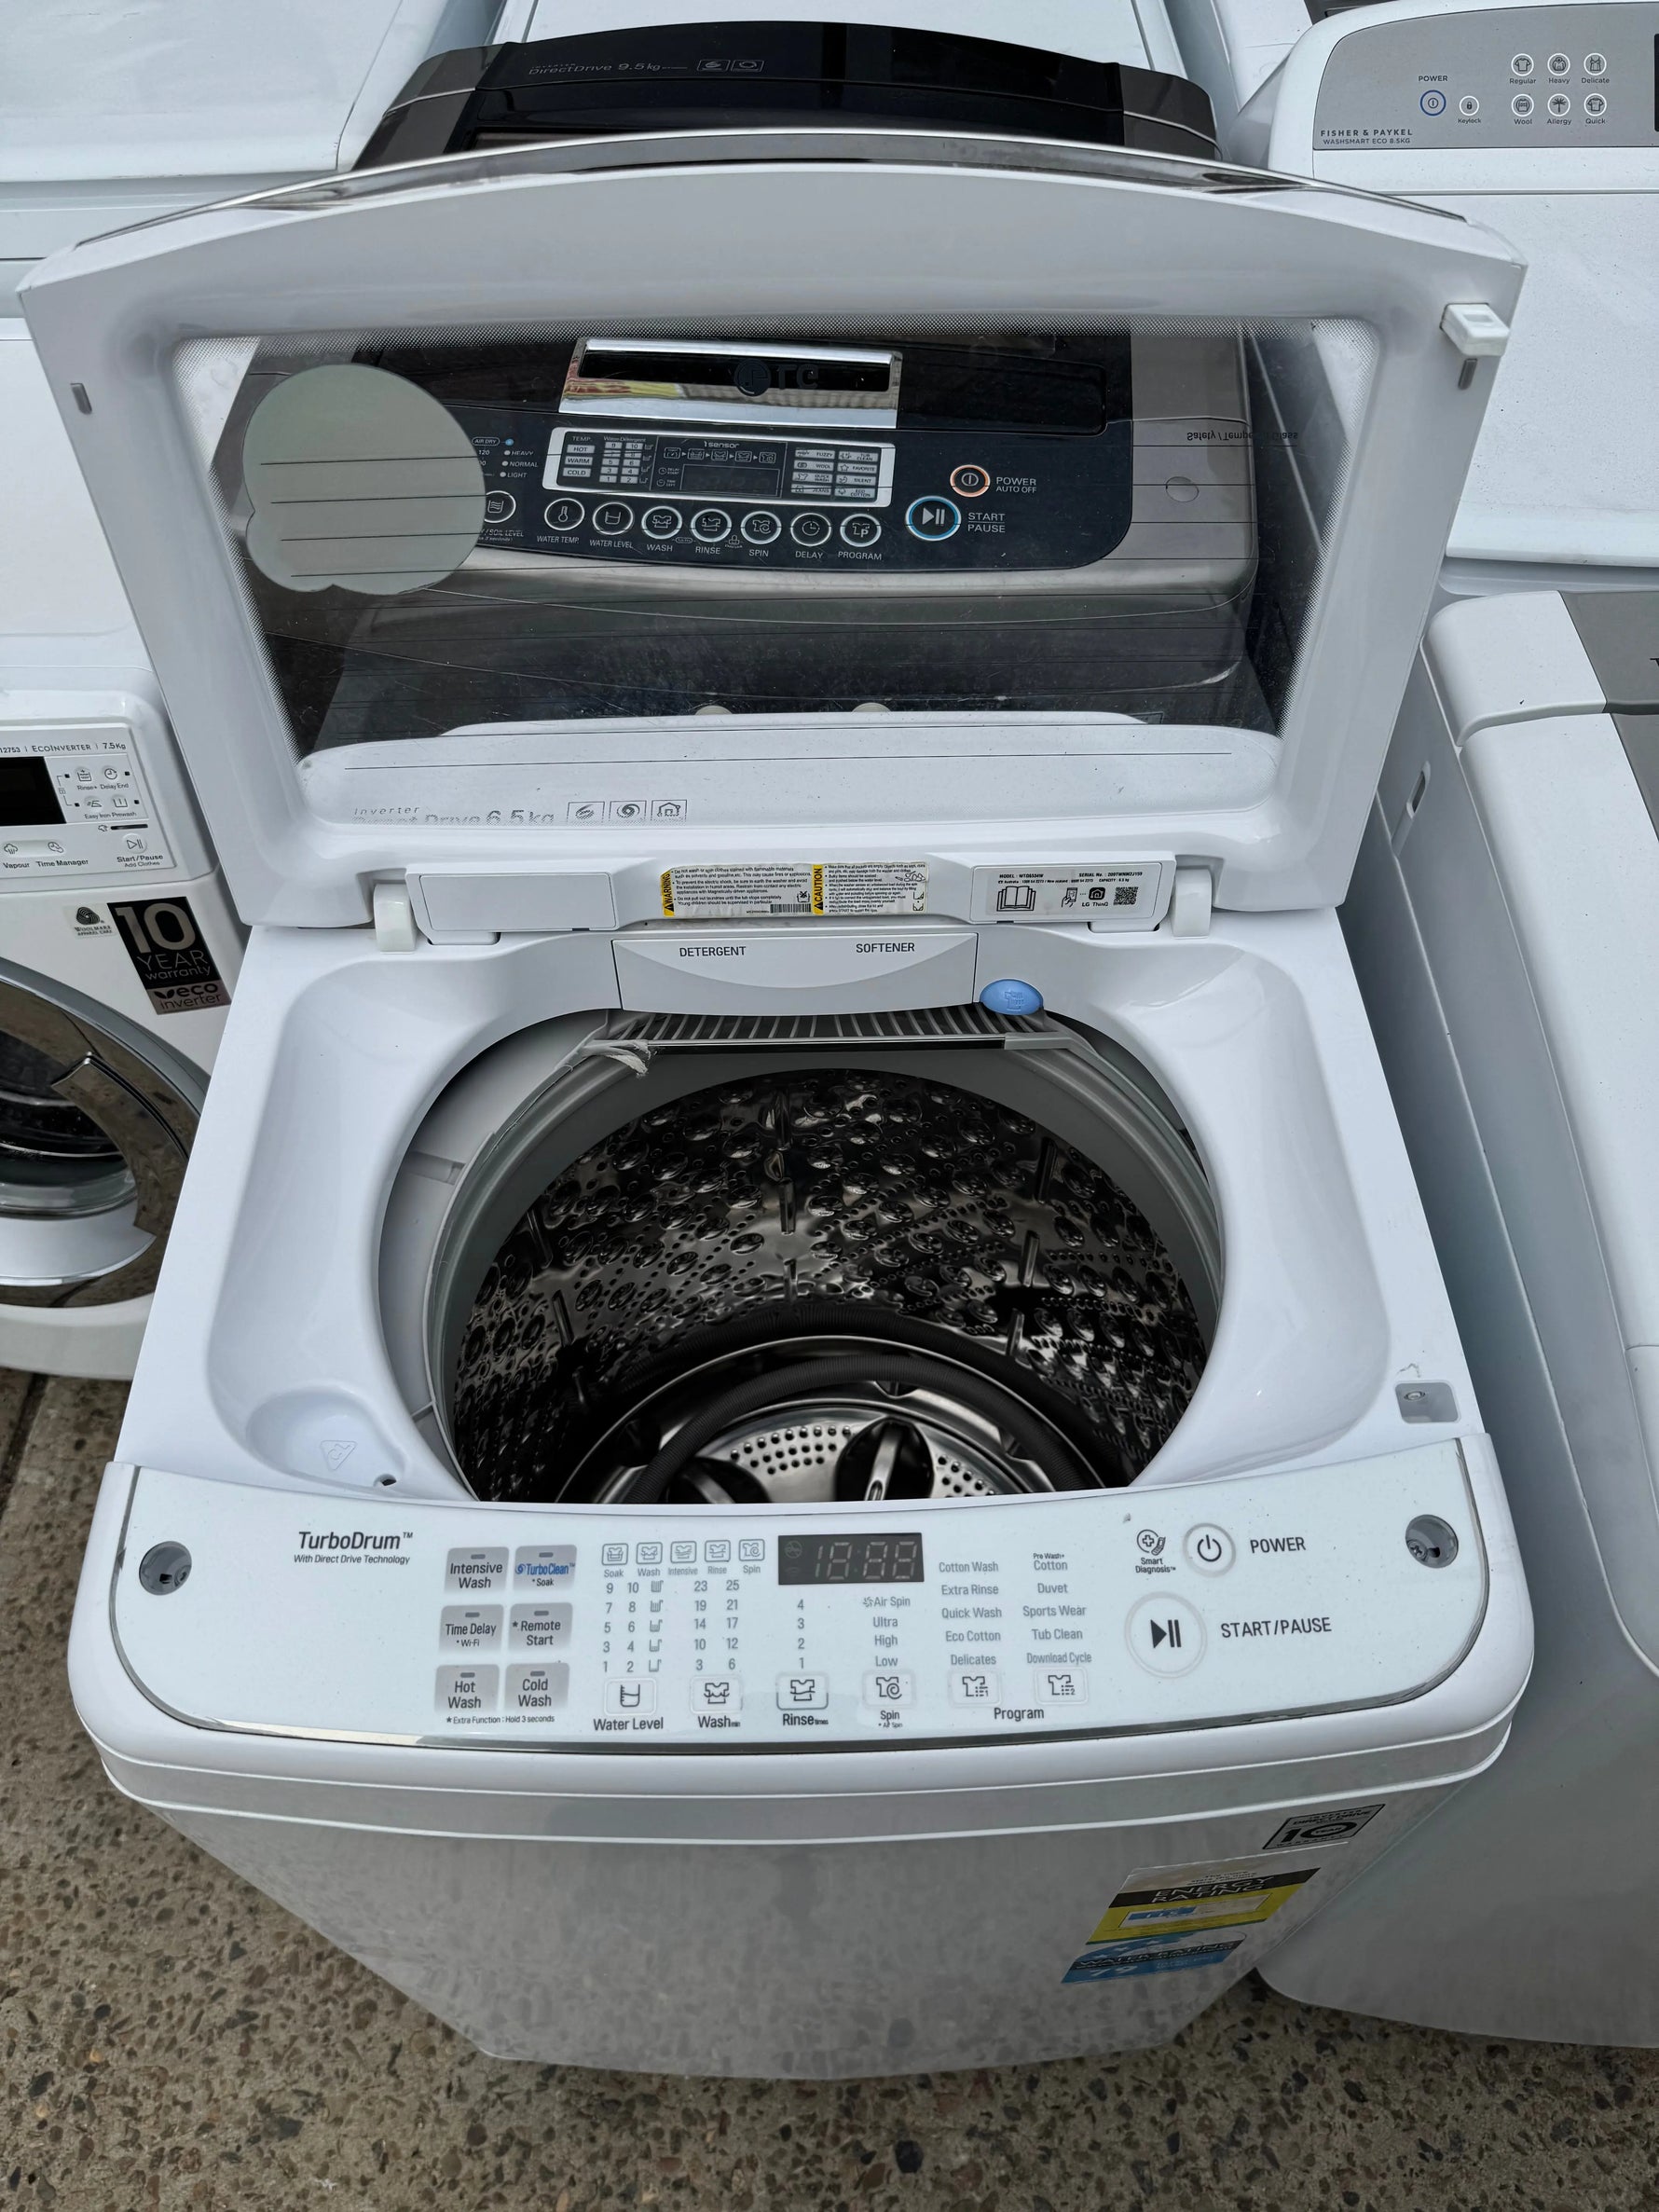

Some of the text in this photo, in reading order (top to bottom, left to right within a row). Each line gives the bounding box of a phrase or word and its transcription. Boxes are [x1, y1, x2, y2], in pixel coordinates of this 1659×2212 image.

[1509, 76, 1611, 85] Regular Heavy Delicate
[1457, 117, 1482, 125] Keylock
[1546, 117, 1572, 127] Allergy
[995, 476, 1036, 486] POWER
[1021, 486, 1037, 494] OFF
[967, 512, 1006, 521] START
[967, 524, 1006, 533] PAUSE
[536, 535, 559, 543] WATER
[589, 539, 634, 549] WATER LEVEL
[646, 543, 673, 552] WASH
[695, 545, 721, 555] RINSE
[748, 549, 770, 557] SPIN
[795, 551, 824, 559] DELAY
[838, 551, 883, 560] PROGRAM
[3, 861, 30, 870] Vapour
[56, 859, 89, 868] Manager
[663, 872, 674, 904] WARNING
[814, 868, 823, 902] CAUTION
[114, 901, 197, 955] 10
[679, 945, 747, 957] DETERGENT
[856, 941, 915, 954] SOFTENER
[136, 949, 209, 972] YEAR
[144, 965, 211, 981] warranty
[175, 982, 219, 998] eco
[160, 993, 222, 1010] inverter
[1250, 1536, 1307, 1554] POWER
[294, 1554, 411, 1565] With Direct Drive Technology
[1034, 1559, 1068, 1571] Cotton
[1140, 1557, 1163, 1565] Smart
[449, 1562, 503, 1575] Intensive
[604, 1564, 761, 1578] Soak Wash Intensive Rinse Spin
[939, 1561, 999, 1573] Cotton Wash
[458, 1576, 491, 1589] Wash
[536, 1577, 555, 1587] Soak
[606, 1582, 639, 1594] 9 10
[693, 1579, 740, 1592] 23 25
[1036, 1582, 1068, 1594] Duvet
[940, 1584, 1000, 1595] Extra Rinse
[606, 1601, 637, 1614] 7 8
[694, 1599, 738, 1612] 19 21
[797, 1599, 805, 1611] 4
[873, 1595, 911, 1609] Air Spin
[941, 1606, 1003, 1619] Quick Wash
[1022, 1605, 1087, 1618] Sports Wear
[520, 1619, 561, 1632] Remote
[604, 1620, 636, 1633] 5 6
[693, 1616, 739, 1629] 14 17
[797, 1617, 805, 1629] 3
[872, 1615, 898, 1628] Ultra
[1221, 1617, 1332, 1638] START/PAUSE
[445, 1623, 497, 1637] Time Delay
[945, 1629, 1001, 1642] Eco Cotton
[1032, 1628, 1083, 1640] Tub Clean
[460, 1638, 480, 1647] Wi-Fi
[526, 1634, 554, 1646] Start
[693, 1637, 739, 1650] 10 12
[798, 1638, 805, 1650] 2
[874, 1633, 898, 1647] High
[602, 1641, 635, 1653] 3 4
[695, 1657, 736, 1670] 3 6
[875, 1655, 898, 1667] Low
[950, 1654, 997, 1665] Delicates
[1026, 1652, 1092, 1666] Download Cycle
[626, 1660, 635, 1672] 2
[454, 1681, 476, 1694] Hot
[522, 1678, 549, 1692] Cold
[447, 1697, 482, 1709] Wash
[517, 1695, 552, 1708] Wash
[453, 1716, 472, 1724] Extra
[472, 1715, 501, 1724] Function
[880, 1711, 900, 1723] Spin
[994, 1707, 1045, 1722] Program
[593, 1717, 664, 1731] Water Level
[1155, 1875, 1275, 1897] ENERGY
[1151, 1884, 1265, 1903] RATING
